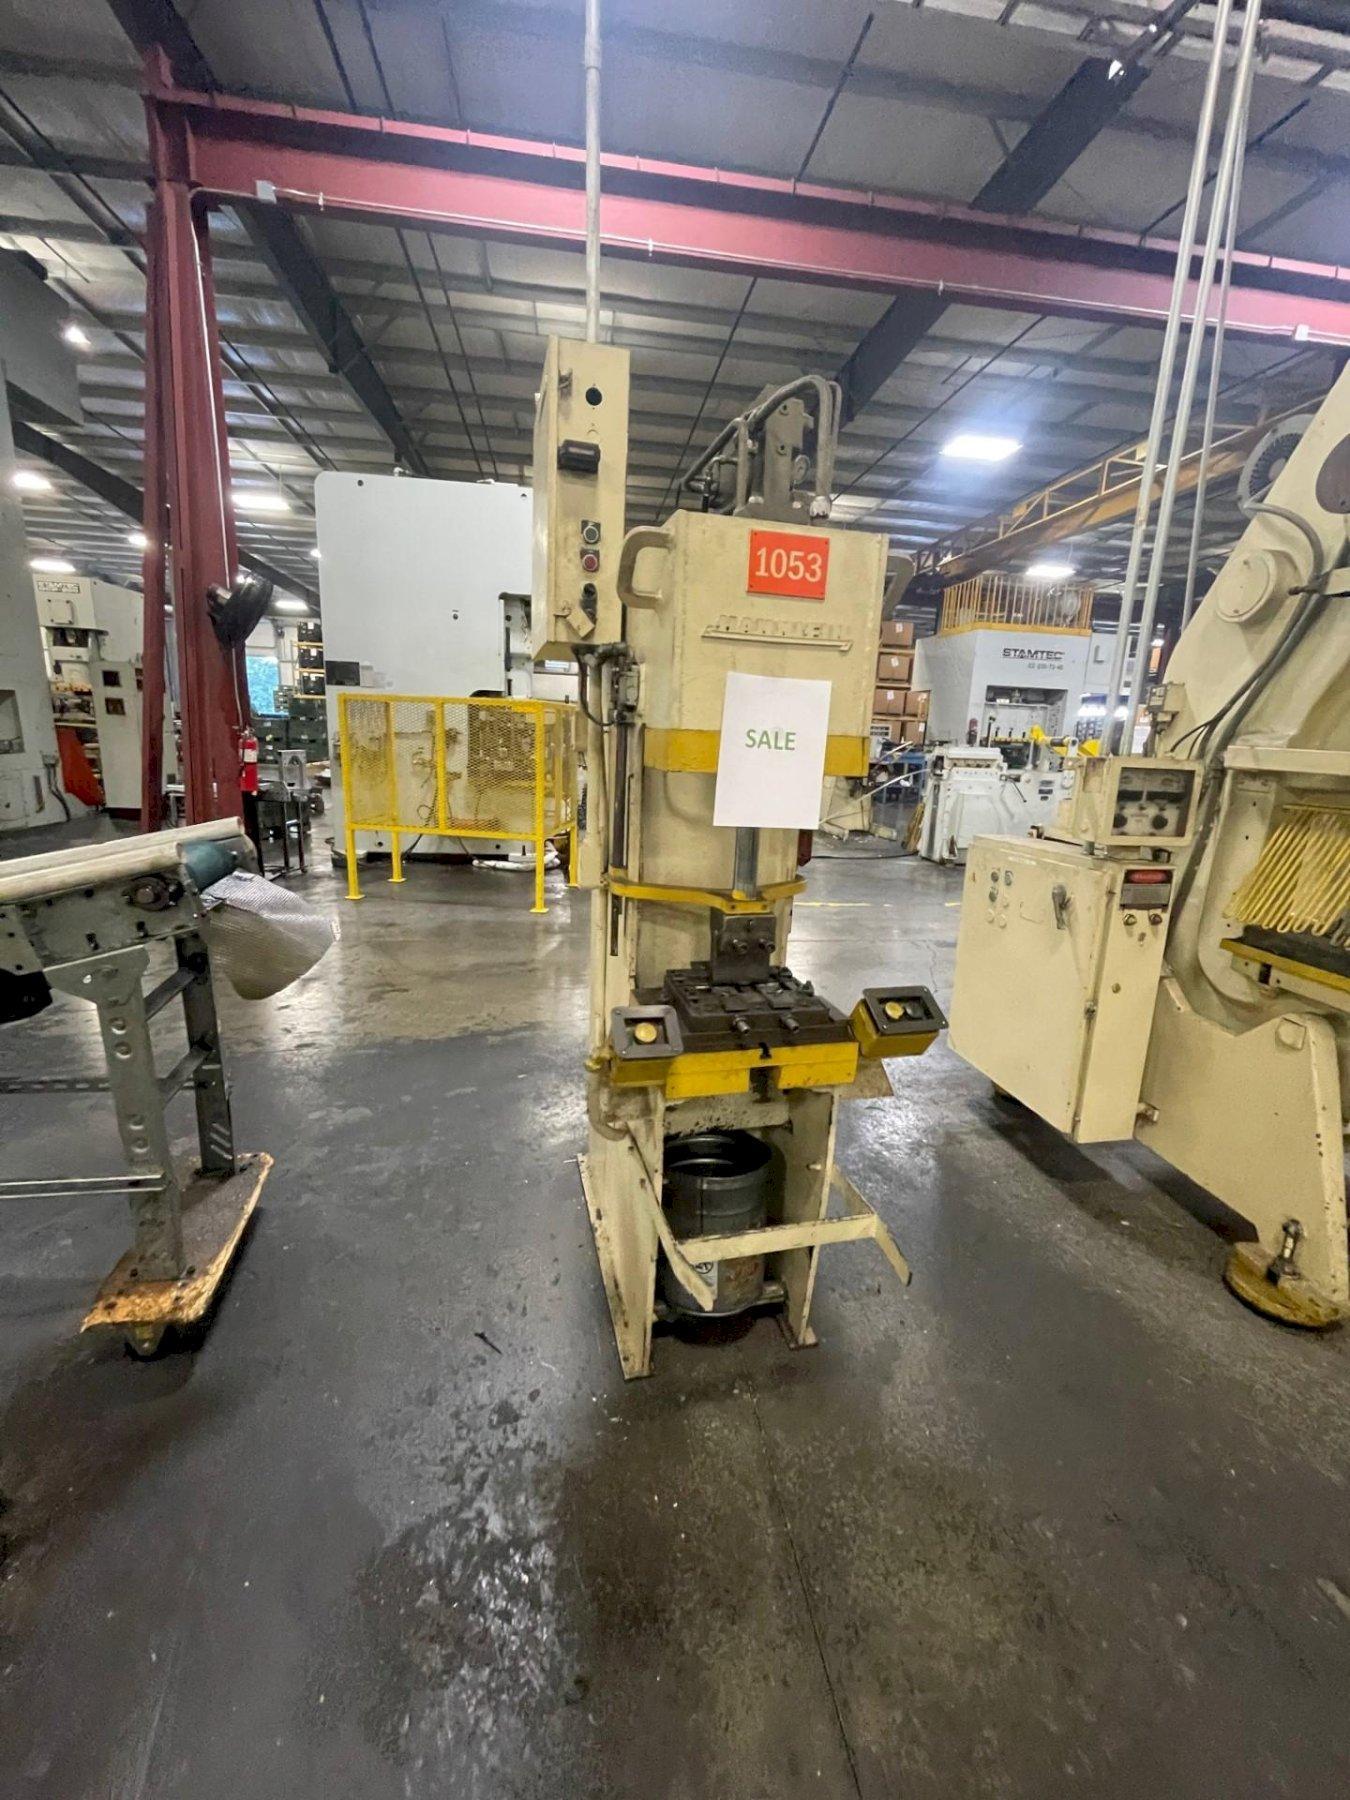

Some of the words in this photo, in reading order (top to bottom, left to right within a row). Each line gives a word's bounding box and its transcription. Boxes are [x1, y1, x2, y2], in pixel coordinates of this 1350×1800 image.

[755, 547, 822, 583] 1053
[1002, 648, 1065, 660] STAMTEC
[745, 728, 796, 751] SALE
